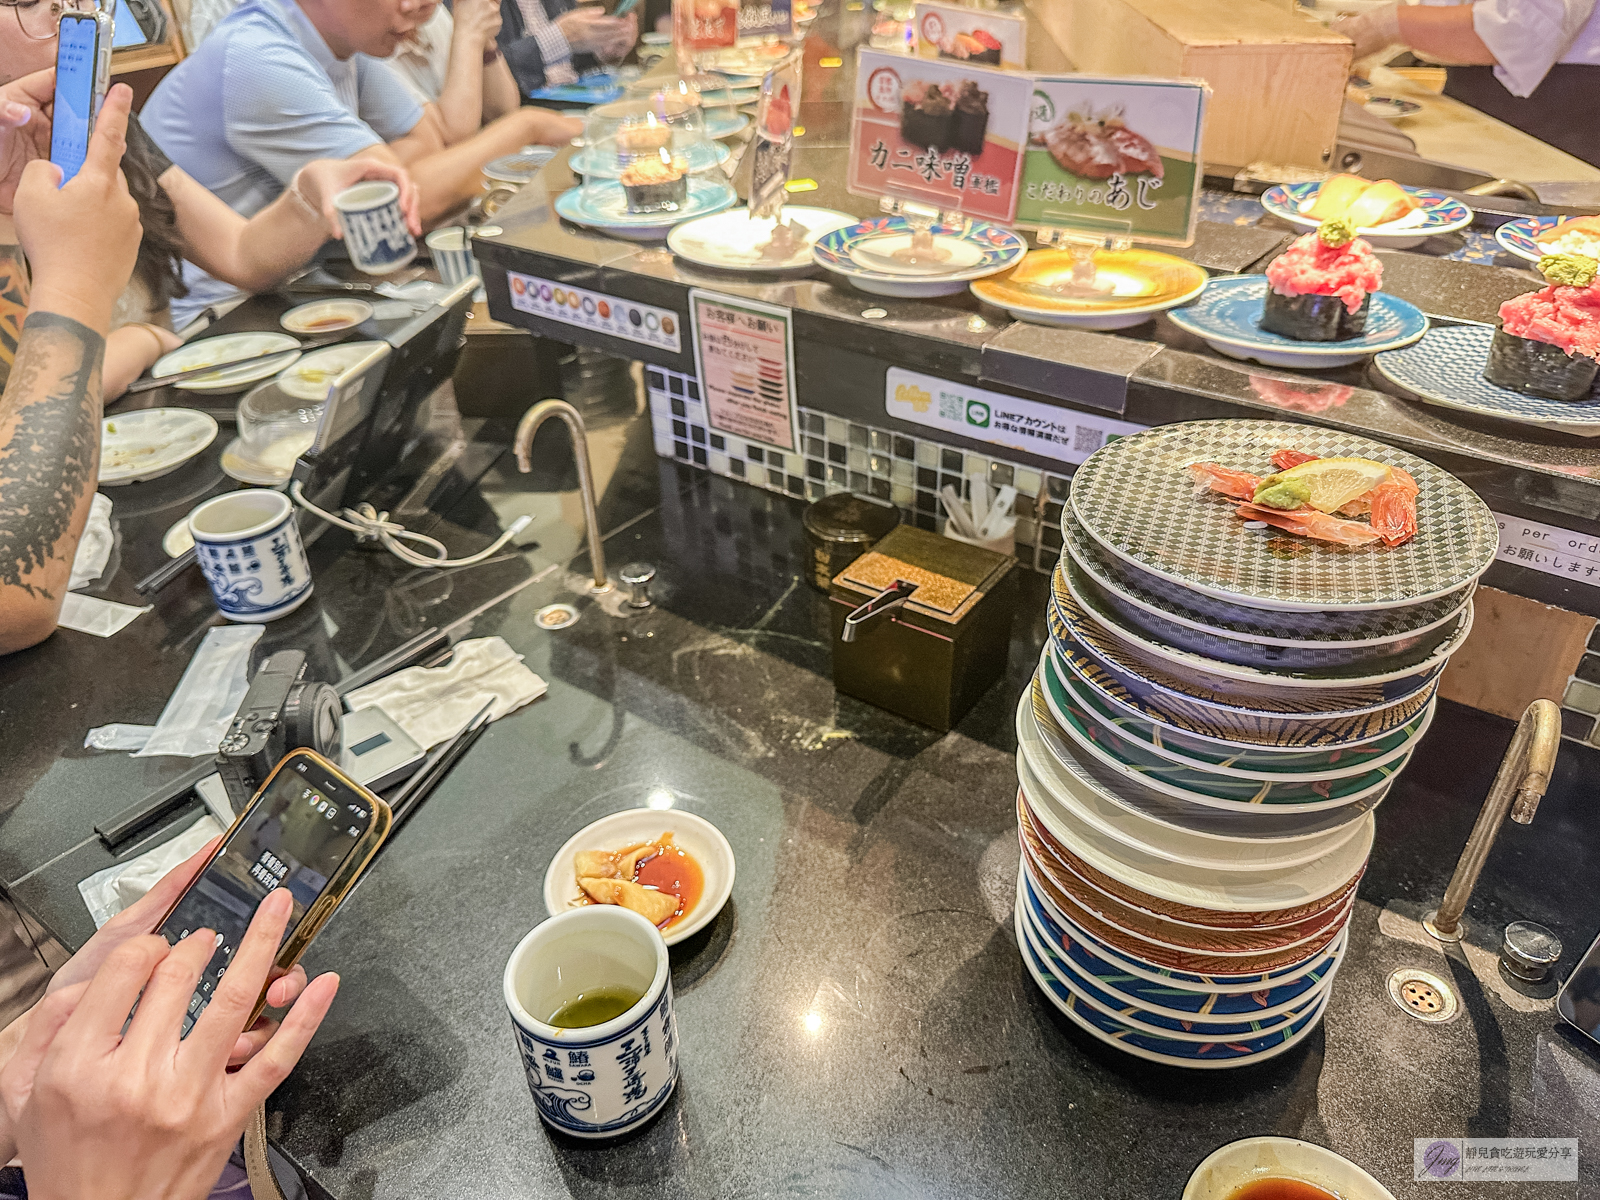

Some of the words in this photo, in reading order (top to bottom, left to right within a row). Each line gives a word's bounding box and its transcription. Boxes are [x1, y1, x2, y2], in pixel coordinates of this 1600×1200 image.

[1521, 527, 1551, 541] per
[1567, 539, 1600, 554] ord
[1502, 544, 1600, 580] お願いします
